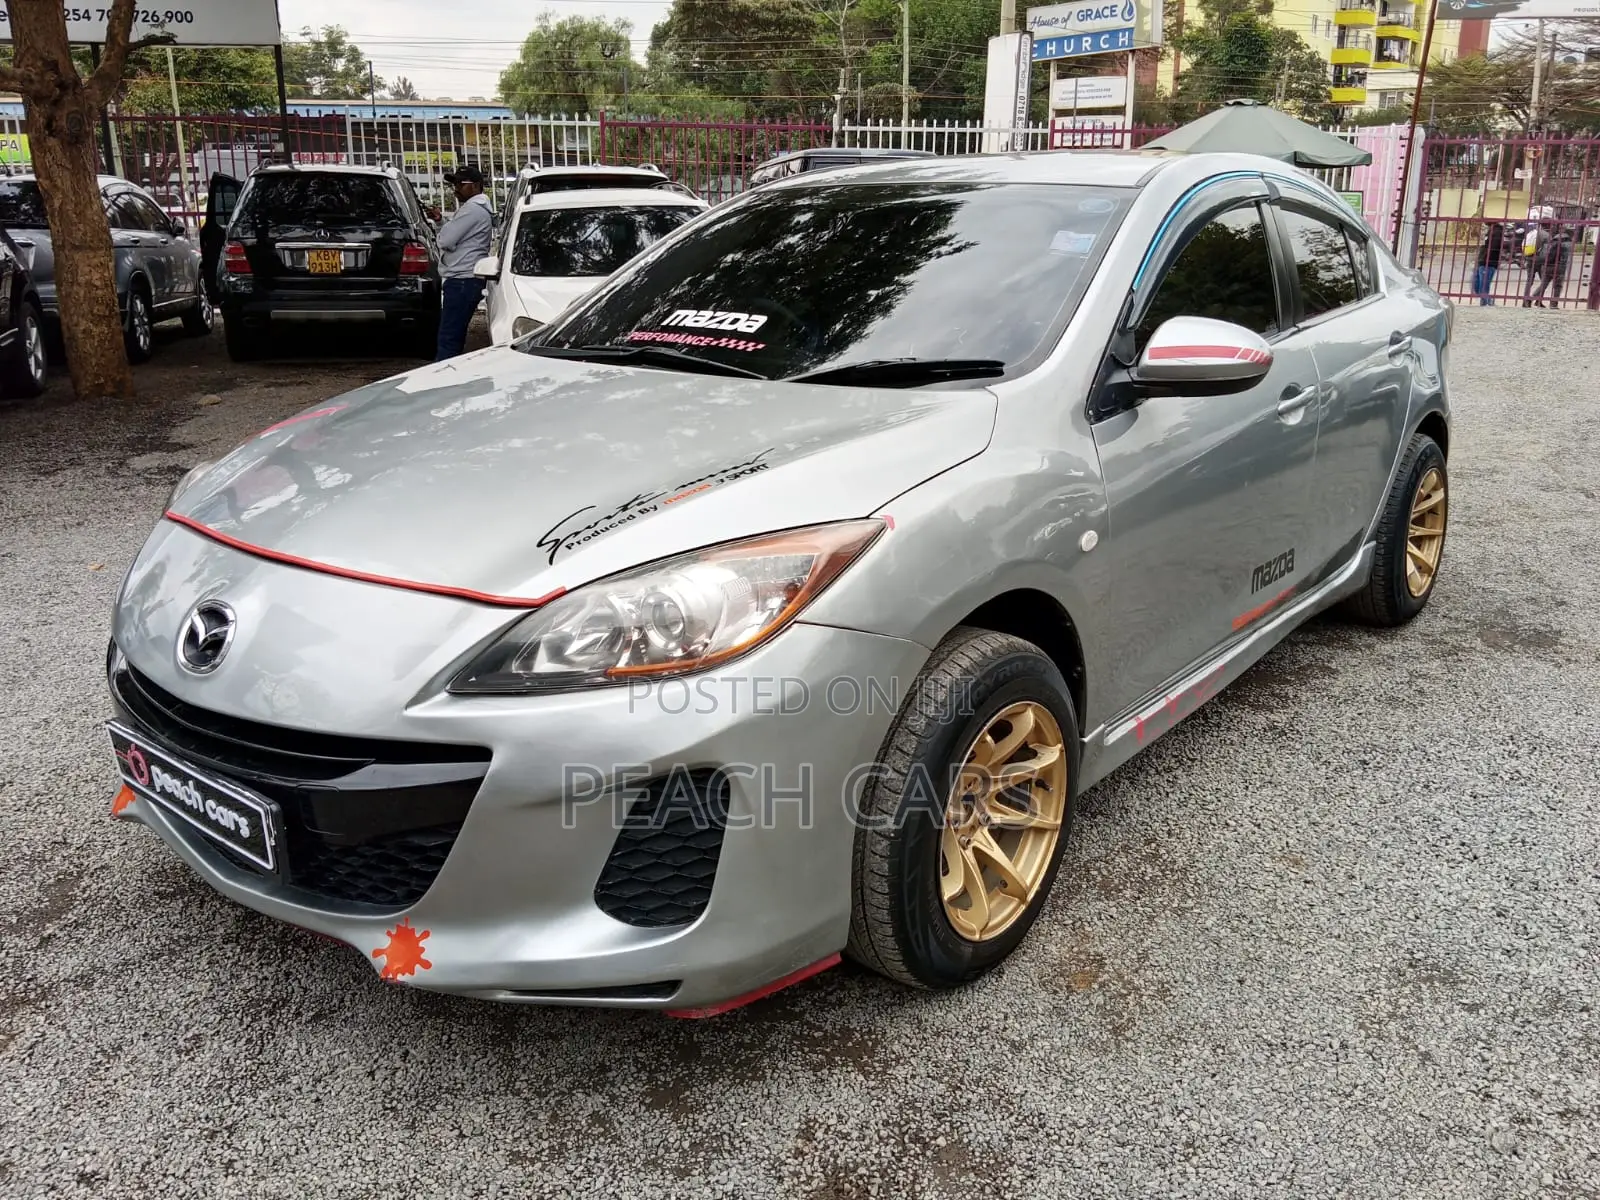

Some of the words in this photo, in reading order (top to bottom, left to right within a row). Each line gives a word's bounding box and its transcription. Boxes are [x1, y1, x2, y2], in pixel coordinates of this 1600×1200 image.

[164, 10, 194, 24] 900
[1030, 16, 1060, 30] House
[1061, 11, 1073, 29] of
[1077, 5, 1118, 22] GRACE
[316, 250, 338, 261] KBY
[627, 331, 713, 347] PERFOMANCE
[565, 514, 636, 550] Produced
[638, 504, 658, 515] By
[1251, 548, 1295, 595] mazda
[151, 764, 205, 813] peach
[205, 799, 251, 839] cars
